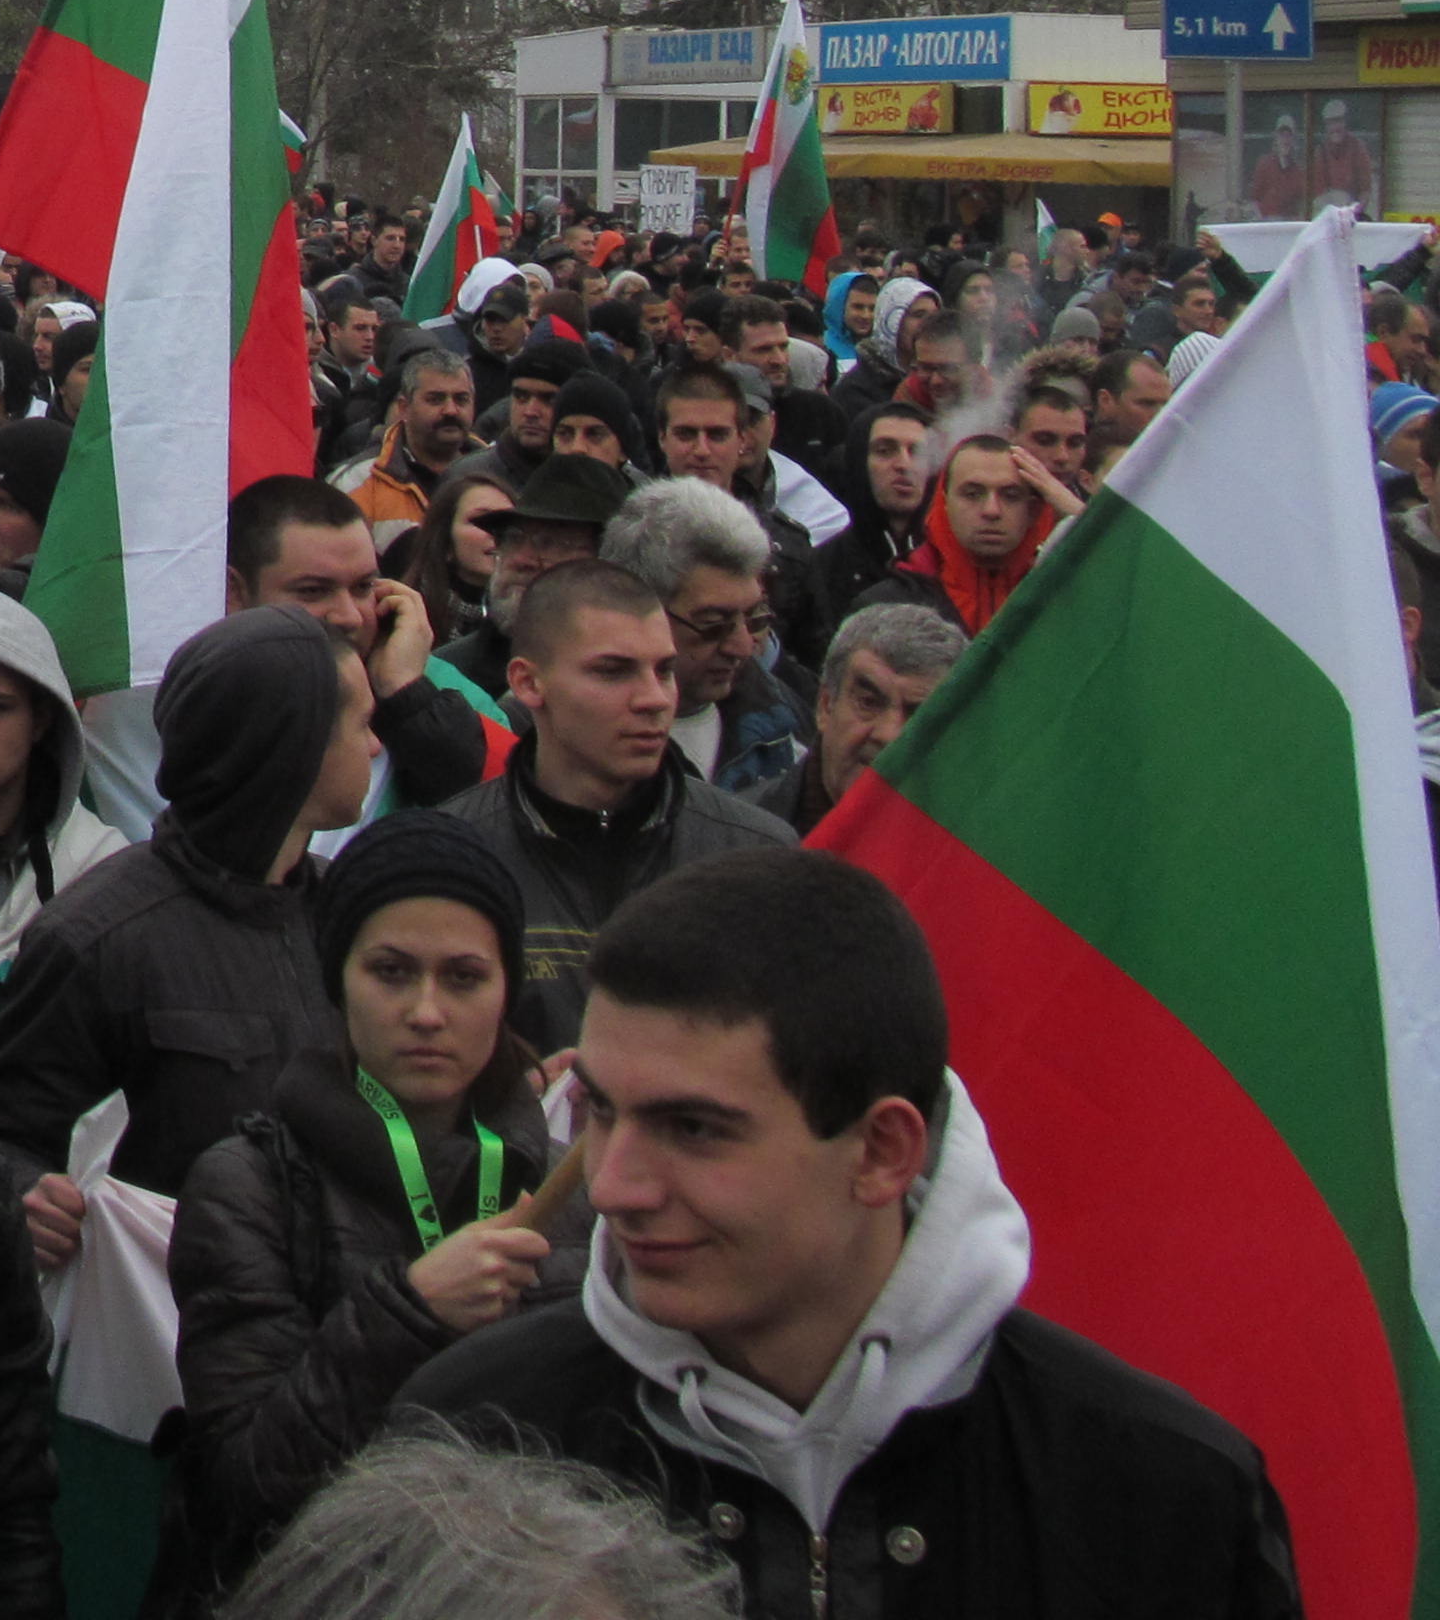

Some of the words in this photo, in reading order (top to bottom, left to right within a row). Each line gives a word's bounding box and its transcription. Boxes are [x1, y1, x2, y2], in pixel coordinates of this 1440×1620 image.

[1173, 17, 1205, 38] 5,1
[1212, 15, 1248, 37] km
[825, 34, 889, 69] ПАЗАР
[853, 87, 902, 106] ЕКСТРА
[853, 107, 902, 127] ДЮНЕР
